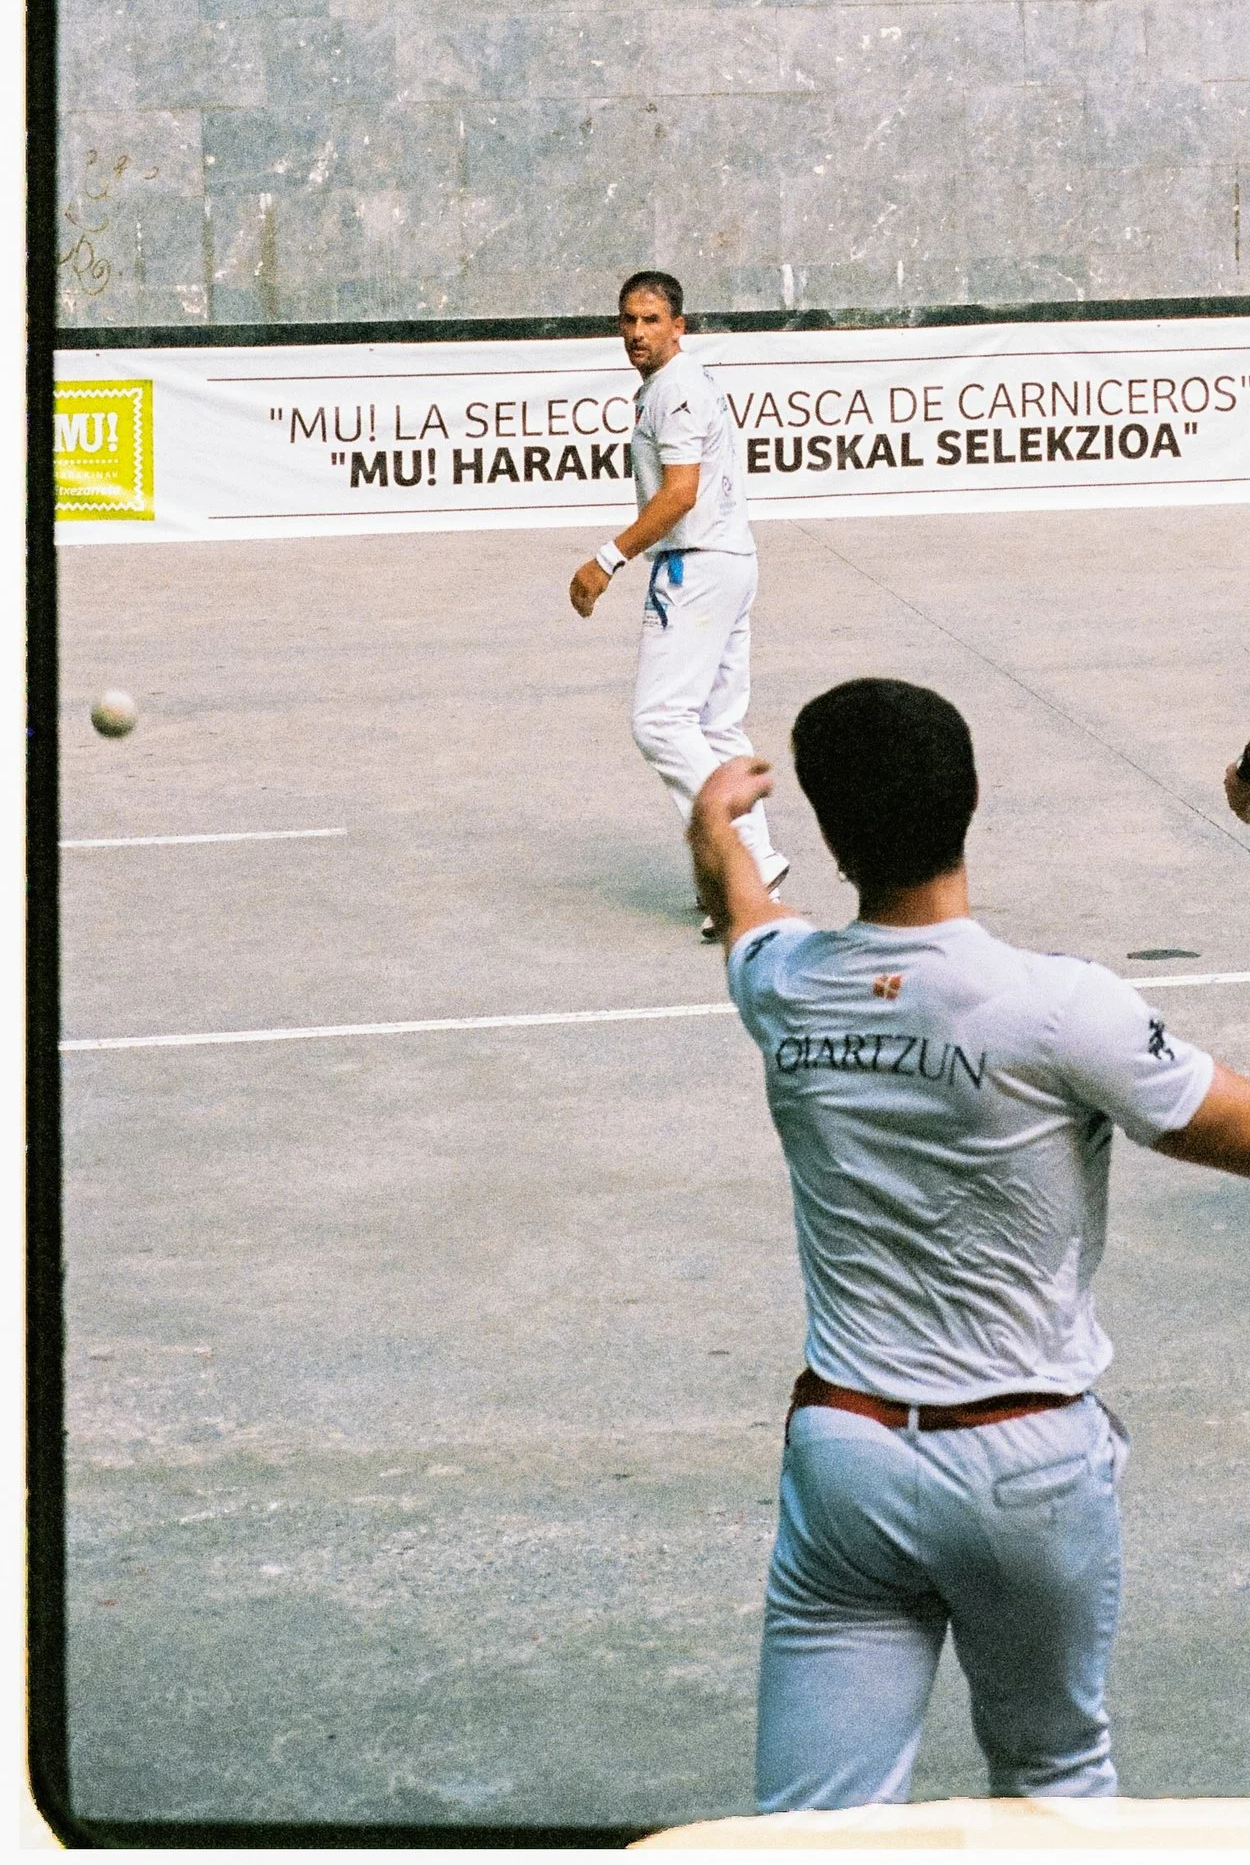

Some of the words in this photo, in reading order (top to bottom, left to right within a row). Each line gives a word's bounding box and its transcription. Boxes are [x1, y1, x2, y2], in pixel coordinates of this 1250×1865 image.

[53, 412, 118, 452] MU!
[270, 403, 376, 443] "MU!
[395, 404, 449, 442] LA
[465, 397, 641, 439] SELECC
[727, 388, 874, 429] VASCA
[889, 384, 944, 425] DE
[331, 447, 436, 488] "MU!
[452, 441, 633, 485] HARAKI
[747, 430, 924, 475] EUSKAL
[936, 420, 1199, 466] SELEKZIOA"
[775, 1033, 986, 1089] OIARTZUN
